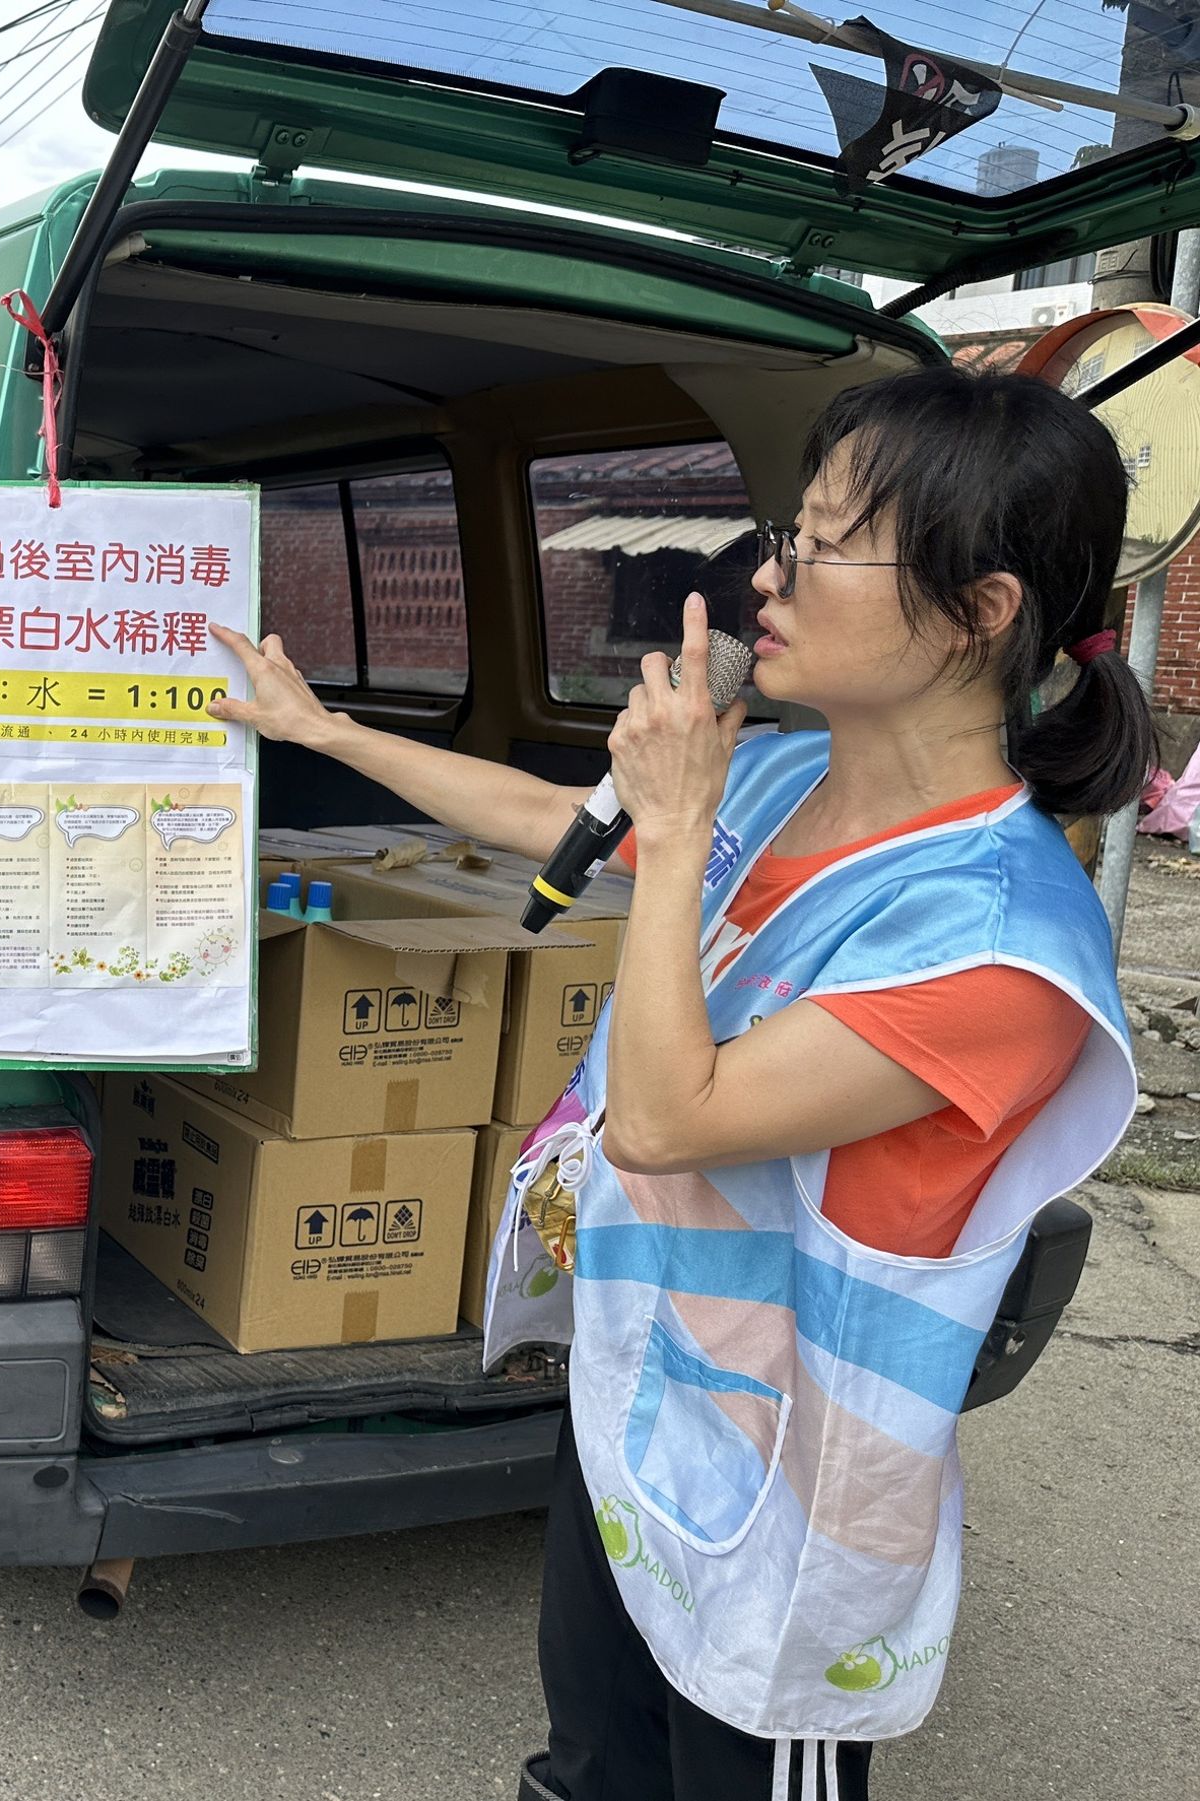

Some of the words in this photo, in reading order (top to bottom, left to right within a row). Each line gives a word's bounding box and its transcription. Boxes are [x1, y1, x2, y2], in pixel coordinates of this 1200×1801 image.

[428, 1017, 442, 1025] DON'T
[443, 1016, 457, 1024] DROP
[572, 1014, 584, 1022] UP
[356, 1021, 368, 1030] UP
[387, 1232, 402, 1240] DON'T
[403, 1231, 417, 1239] DROP
[308, 1236, 322, 1245] UP
[638, 1552, 695, 1614] MADOU
[892, 1635, 950, 1673] MADO
